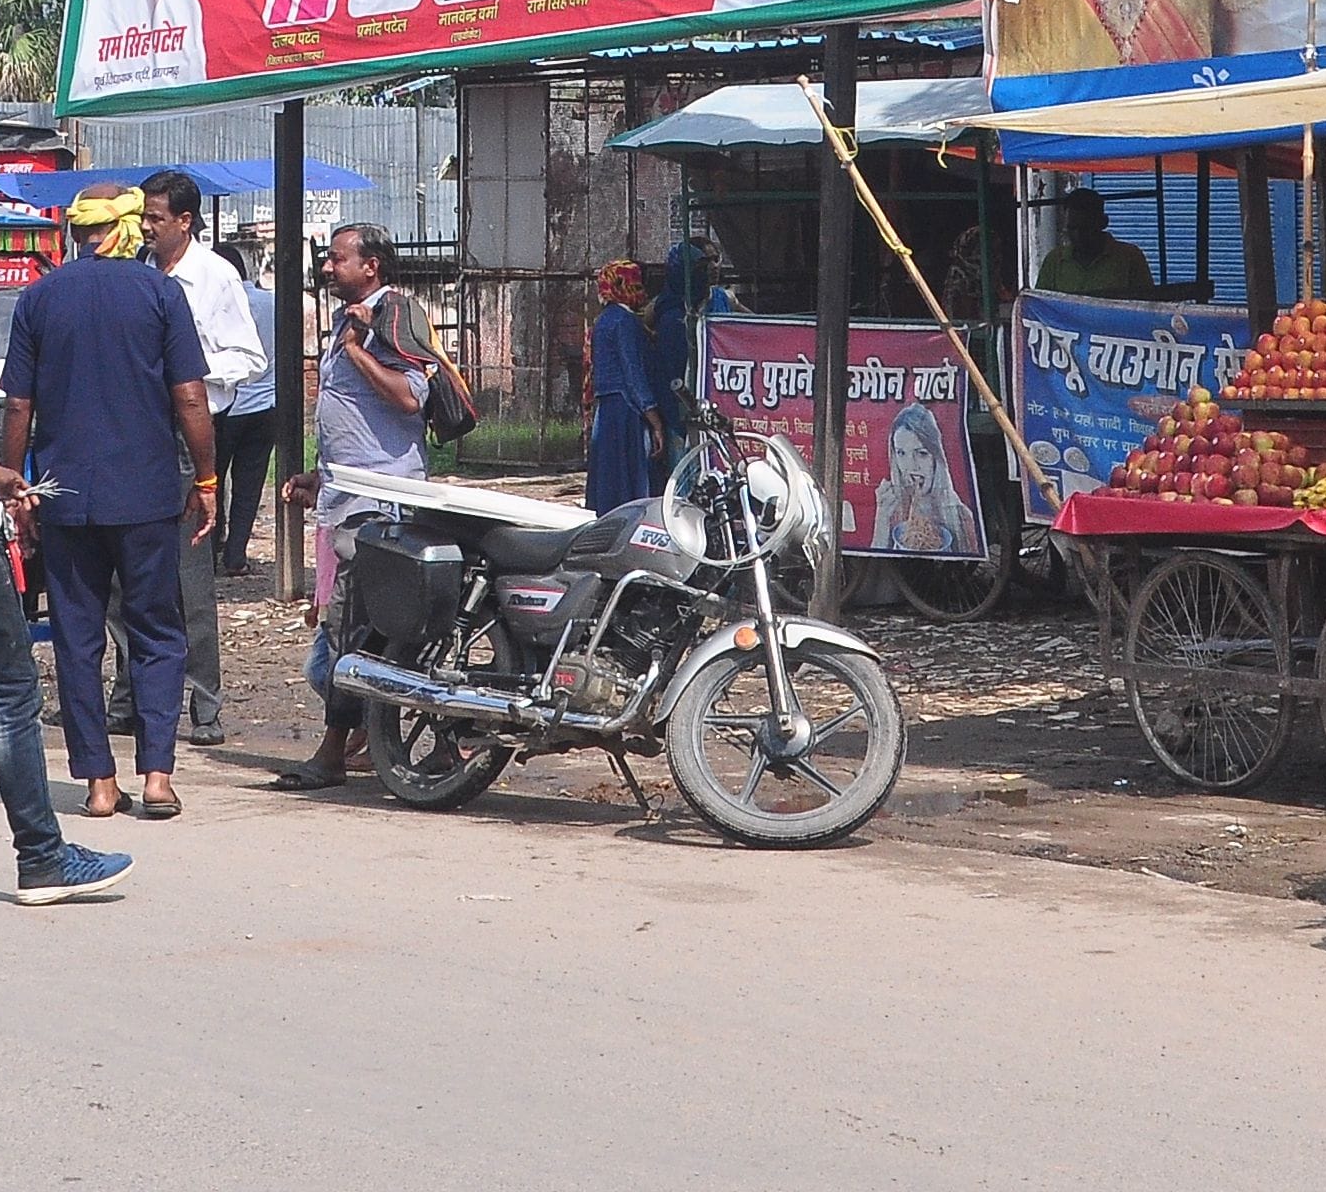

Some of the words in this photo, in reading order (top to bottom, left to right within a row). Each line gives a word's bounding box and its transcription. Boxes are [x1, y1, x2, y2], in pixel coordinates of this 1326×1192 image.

[356, 18, 383, 38] प्रमोद
[383, 15, 408, 34] पटेल
[438, 4, 477, 27] मानवेन्द्र
[476, 0, 500, 21] वर्मा
[98, 35, 124, 63] राम
[124, 22, 150, 59] सिंह
[150, 20, 188, 56] पटेल
[295, 26, 321, 46] पटेल
[1022, 317, 1087, 394] राजू
[1087, 328, 1206, 391] चाउमीन
[711, 357, 756, 408] राजू
[762, 353, 816, 408] पुराने
[912, 357, 959, 401] वाले
[640, 529, 671, 547] TVS
